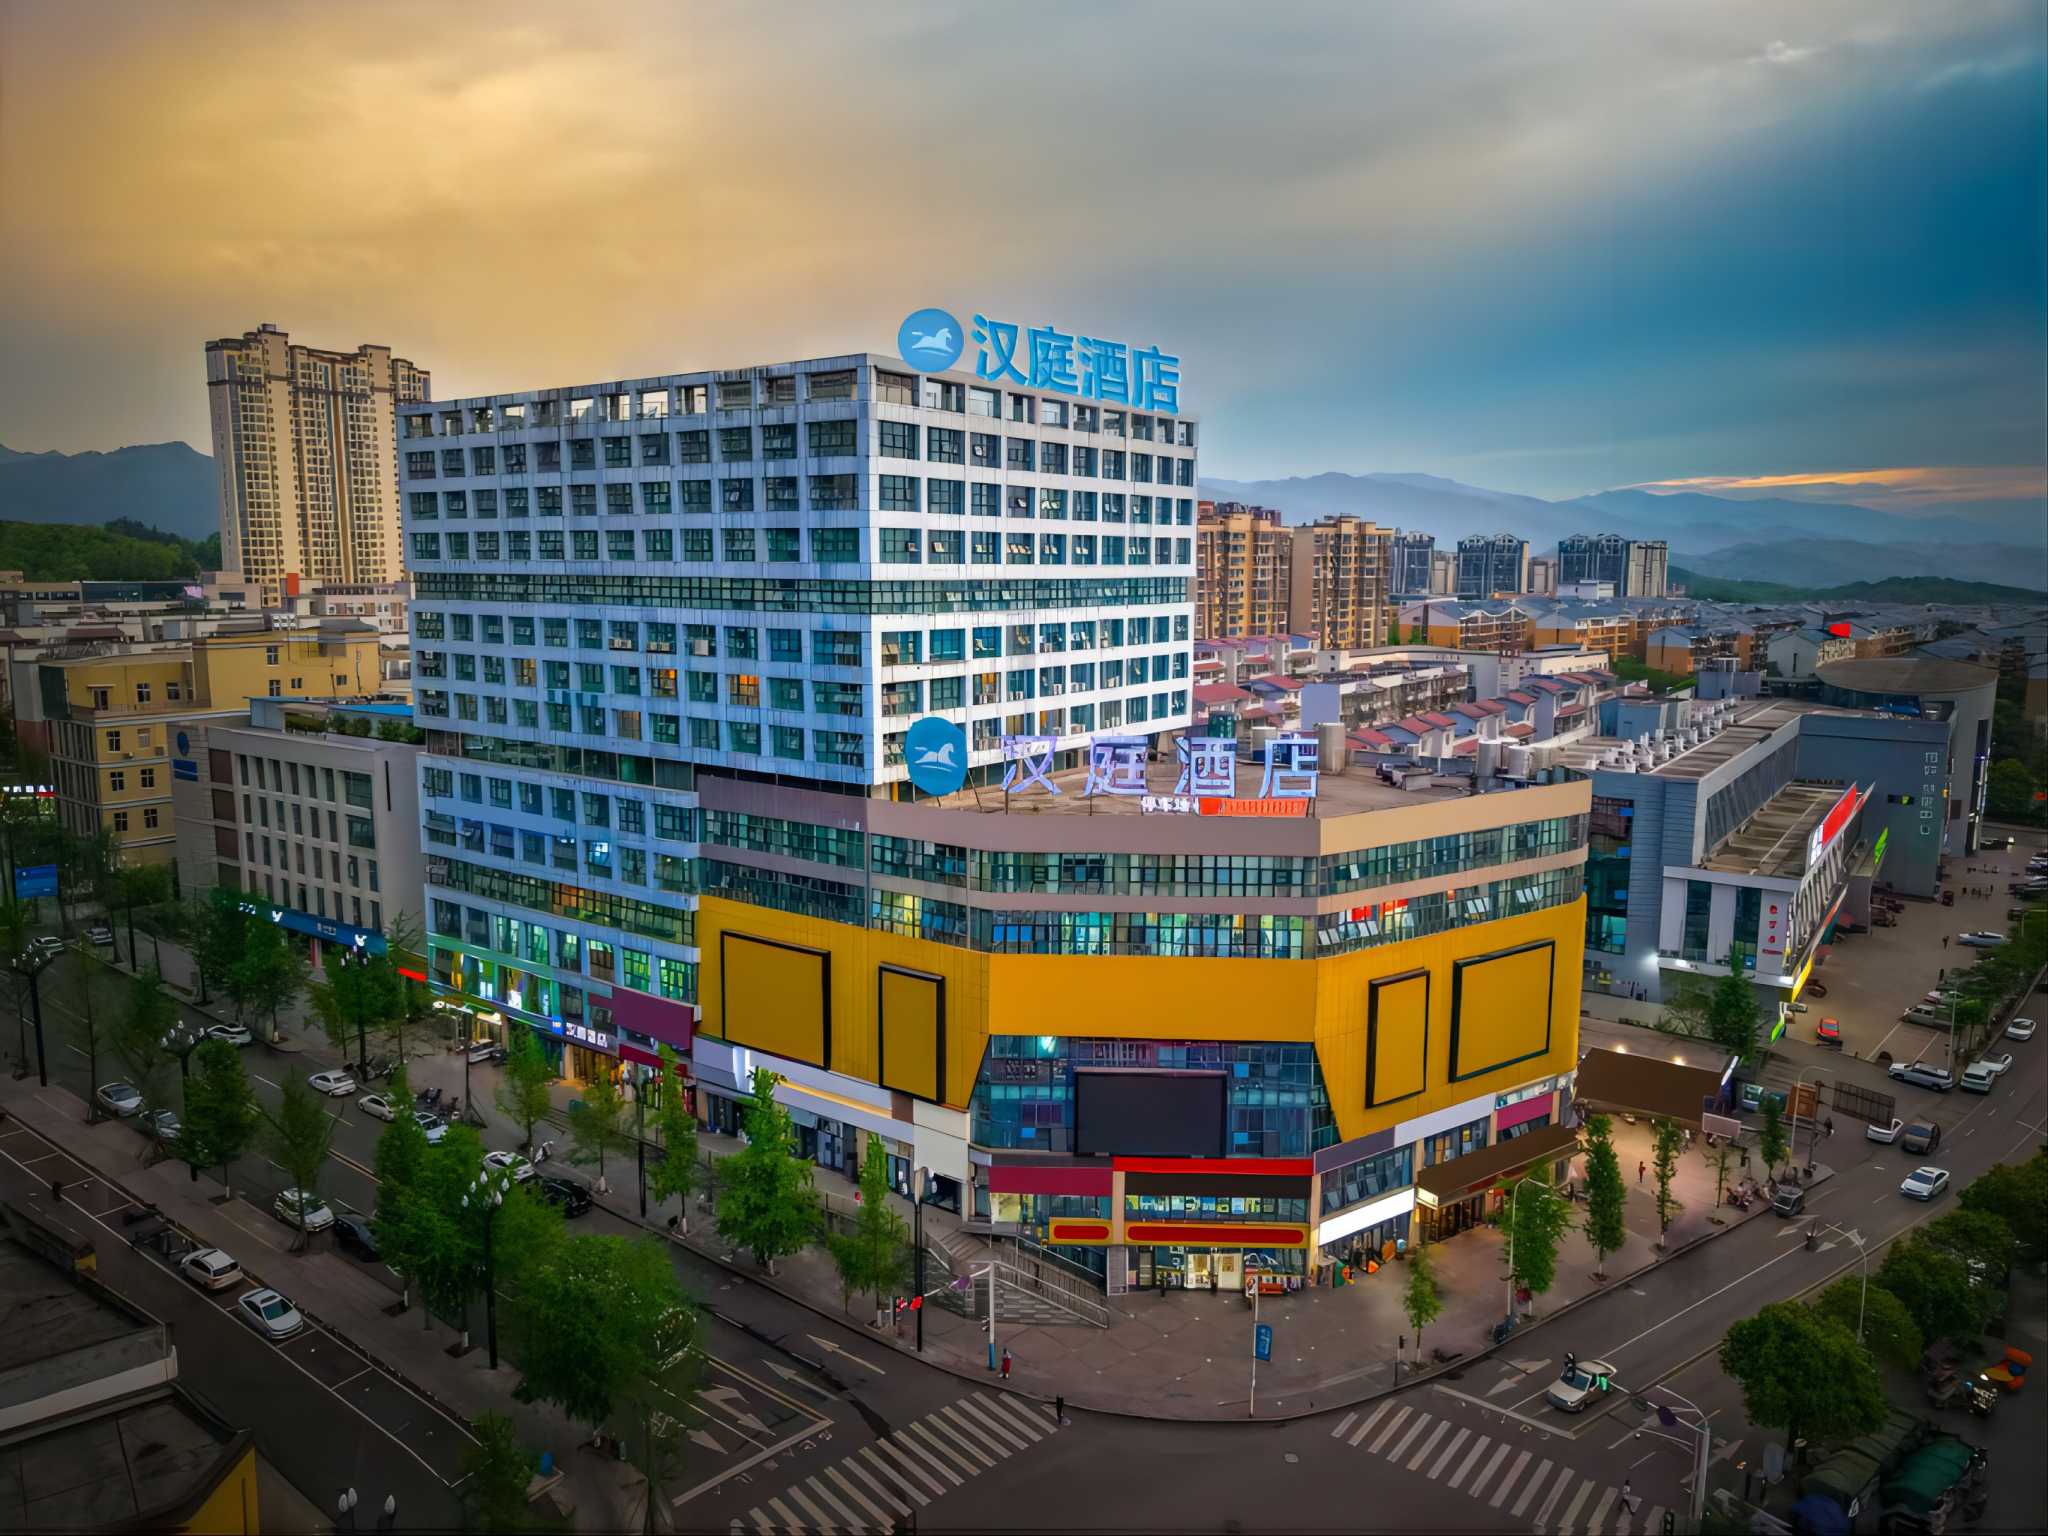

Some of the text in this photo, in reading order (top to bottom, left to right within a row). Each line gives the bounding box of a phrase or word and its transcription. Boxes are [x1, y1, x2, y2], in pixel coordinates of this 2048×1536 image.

[971, 312, 1180, 415] 汉庭酒店
[1001, 734, 1319, 798] 汉庭酒店
